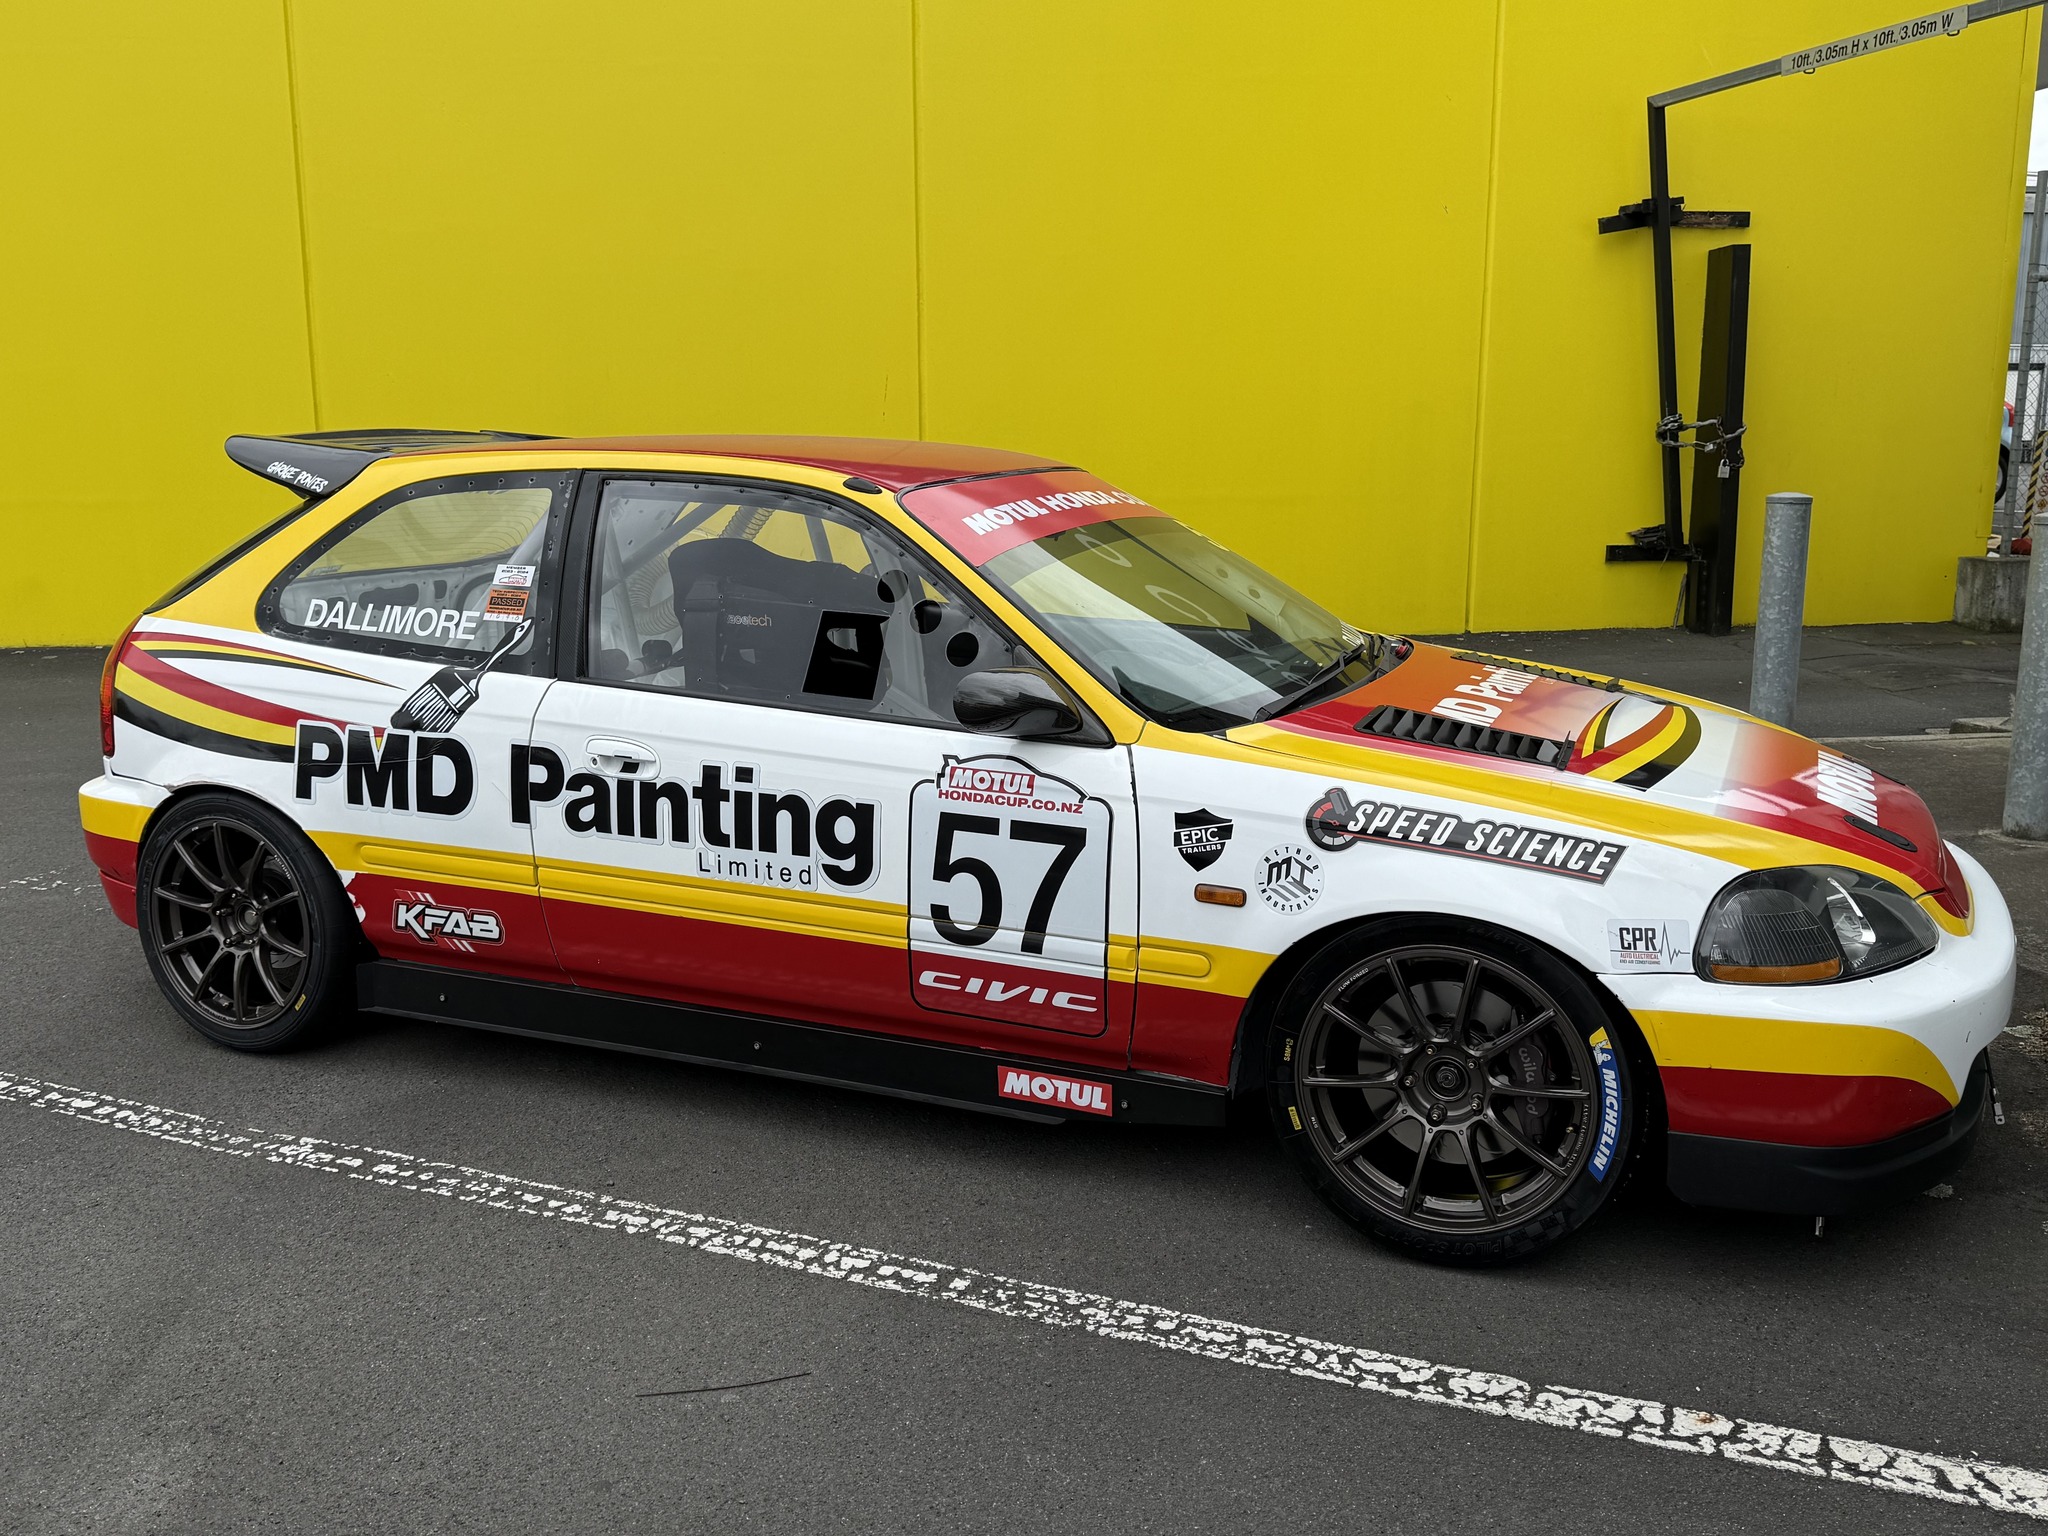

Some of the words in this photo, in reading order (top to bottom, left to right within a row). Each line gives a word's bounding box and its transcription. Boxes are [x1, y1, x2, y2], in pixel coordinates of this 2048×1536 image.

[1851, 38, 1860, 54] H
[1862, 41, 1869, 51] x
[1941, 12, 1954, 29] W
[962, 498, 1050, 536] MOTUL
[1036, 490, 1118, 512] HONDA
[304, 599, 480, 640] DALLIMORE
[491, 597, 523, 606] PASSED
[950, 767, 1034, 795] MOTUL
[1817, 750, 1879, 826] MOTUL
[296, 723, 474, 816] PMD
[510, 743, 875, 887] Painting
[938, 788, 1084, 815] HONDACUP.CO.NZ
[1180, 827, 1220, 846] EPIC
[1181, 843, 1222, 855] TRAILERS
[1347, 803, 1458, 846] SPEED
[1465, 822, 1619, 876] SCIENCE
[699, 852, 811, 885] Limited
[1263, 846, 1319, 871] METHOD
[930, 811, 1088, 955] 57
[1258, 881, 1319, 913] INDUSTRIES
[397, 904, 500, 940] KFAB
[1619, 927, 1657, 951] CPR
[918, 970, 1098, 1013] CIVIC
[1003, 1071, 1108, 1111] MOTUL
[1593, 1068, 1619, 1172] MICHELIN
